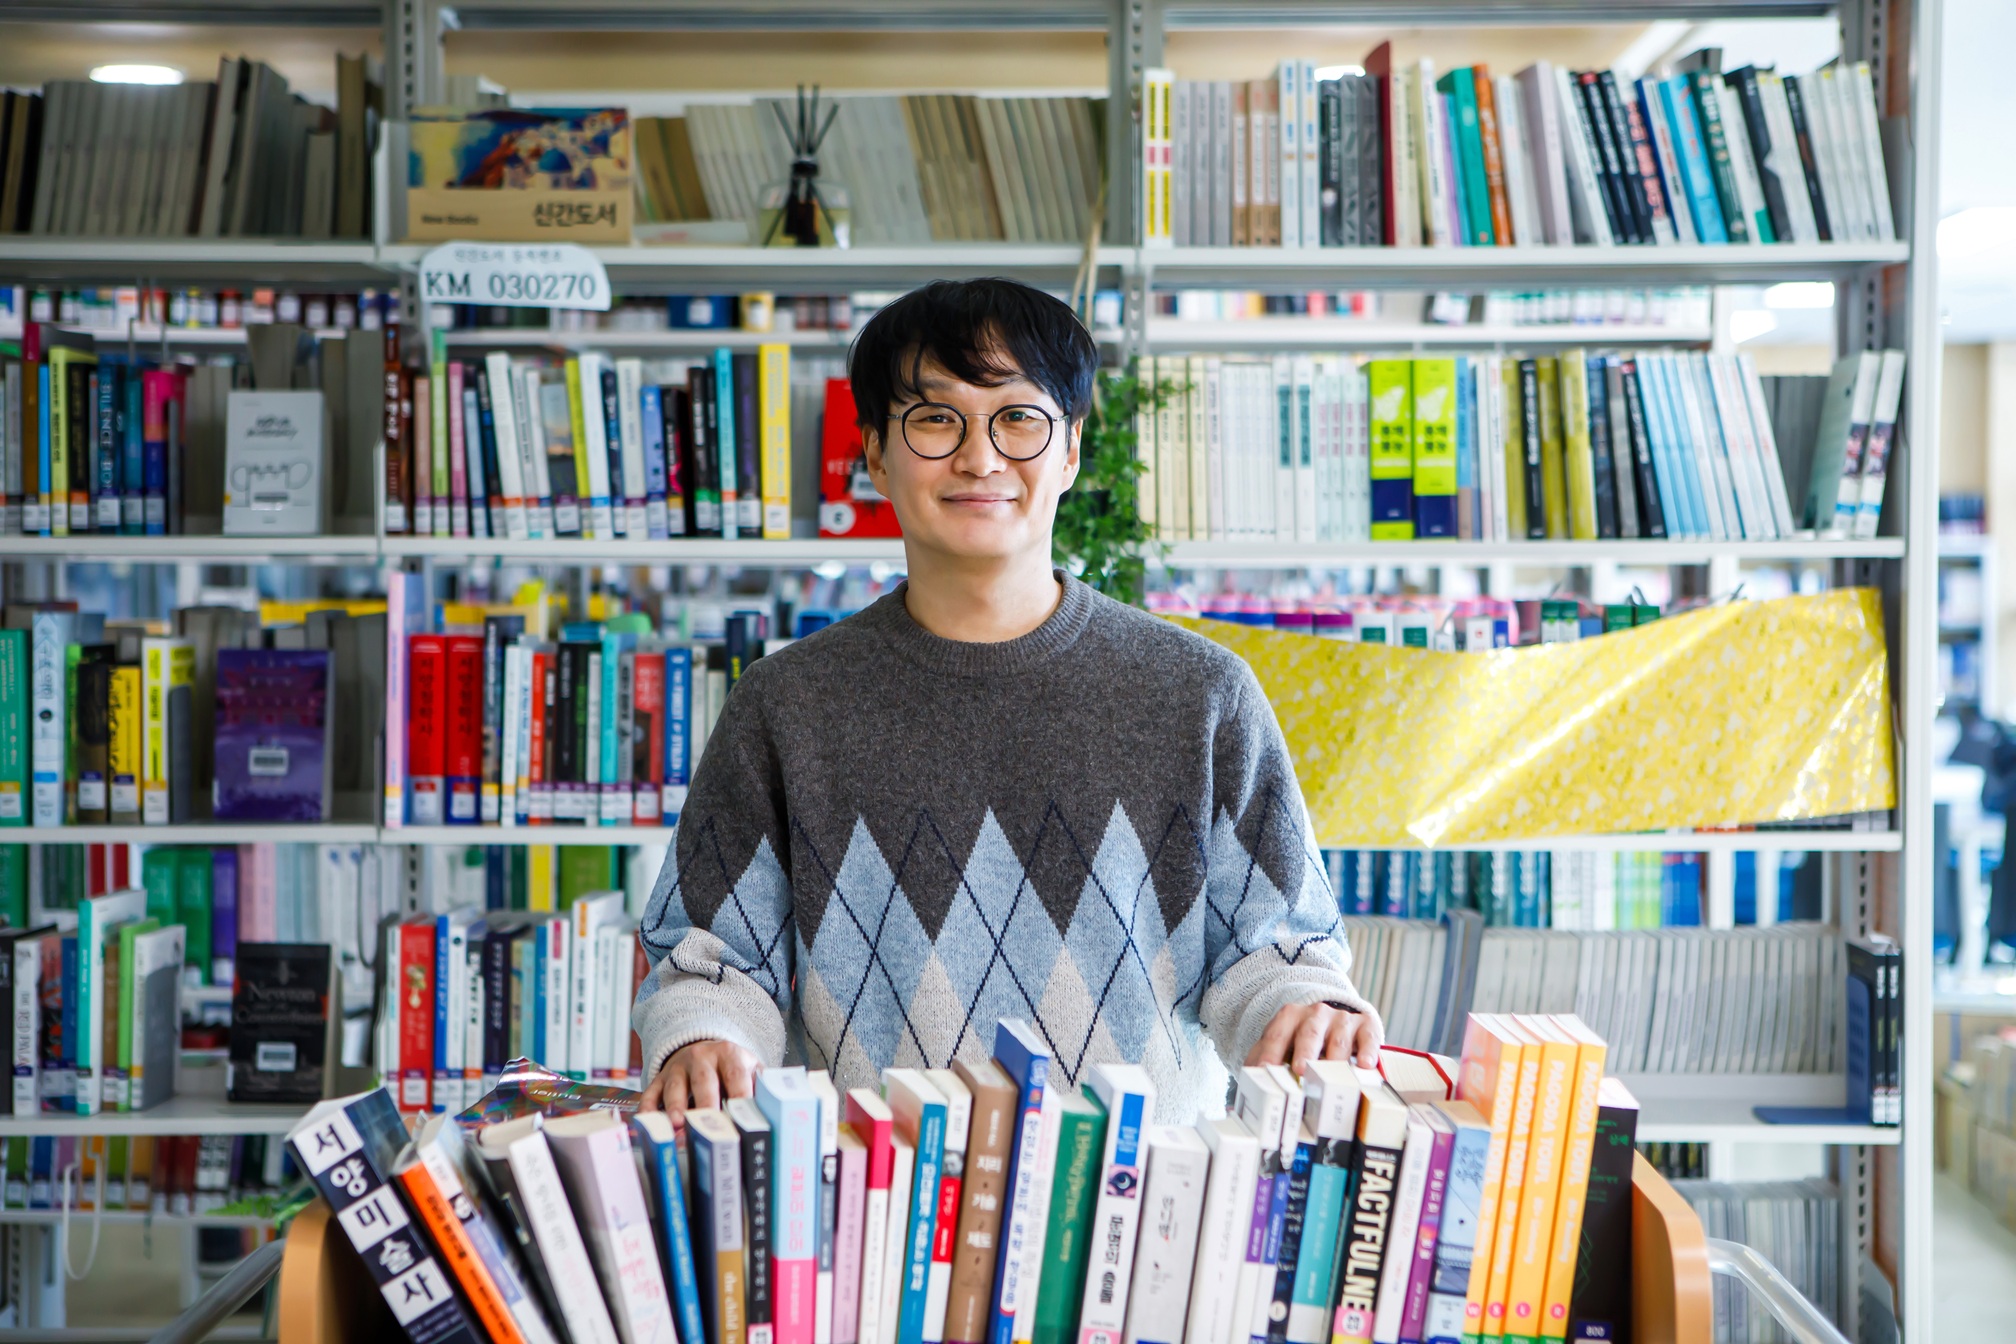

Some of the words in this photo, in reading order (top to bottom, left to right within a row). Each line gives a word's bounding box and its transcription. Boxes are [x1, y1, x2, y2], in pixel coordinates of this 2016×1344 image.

[534, 202, 617, 227] 신간도서
[425, 271, 473, 297] KM
[488, 273, 597, 301] 030270
[1492, 1061, 1517, 1134] PAGODA
[1514, 1061, 1539, 1136] PAGODA
[1541, 1060, 1566, 1134] PAGODA
[1575, 1061, 1600, 1135] PAGODA
[1484, 1138, 1505, 1186] TOEFL
[1506, 1140, 1528, 1189] TOEFL
[1534, 1137, 1555, 1185] TOEFL
[1568, 1138, 1590, 1186] TOEFL
[313, 1121, 434, 1303] 서양미술사
[971, 1192, 997, 1212] 기술
[1343, 1153, 1396, 1312] FACTFULNE
[723, 1271, 737, 1294] the
[723, 1295, 739, 1330] child
